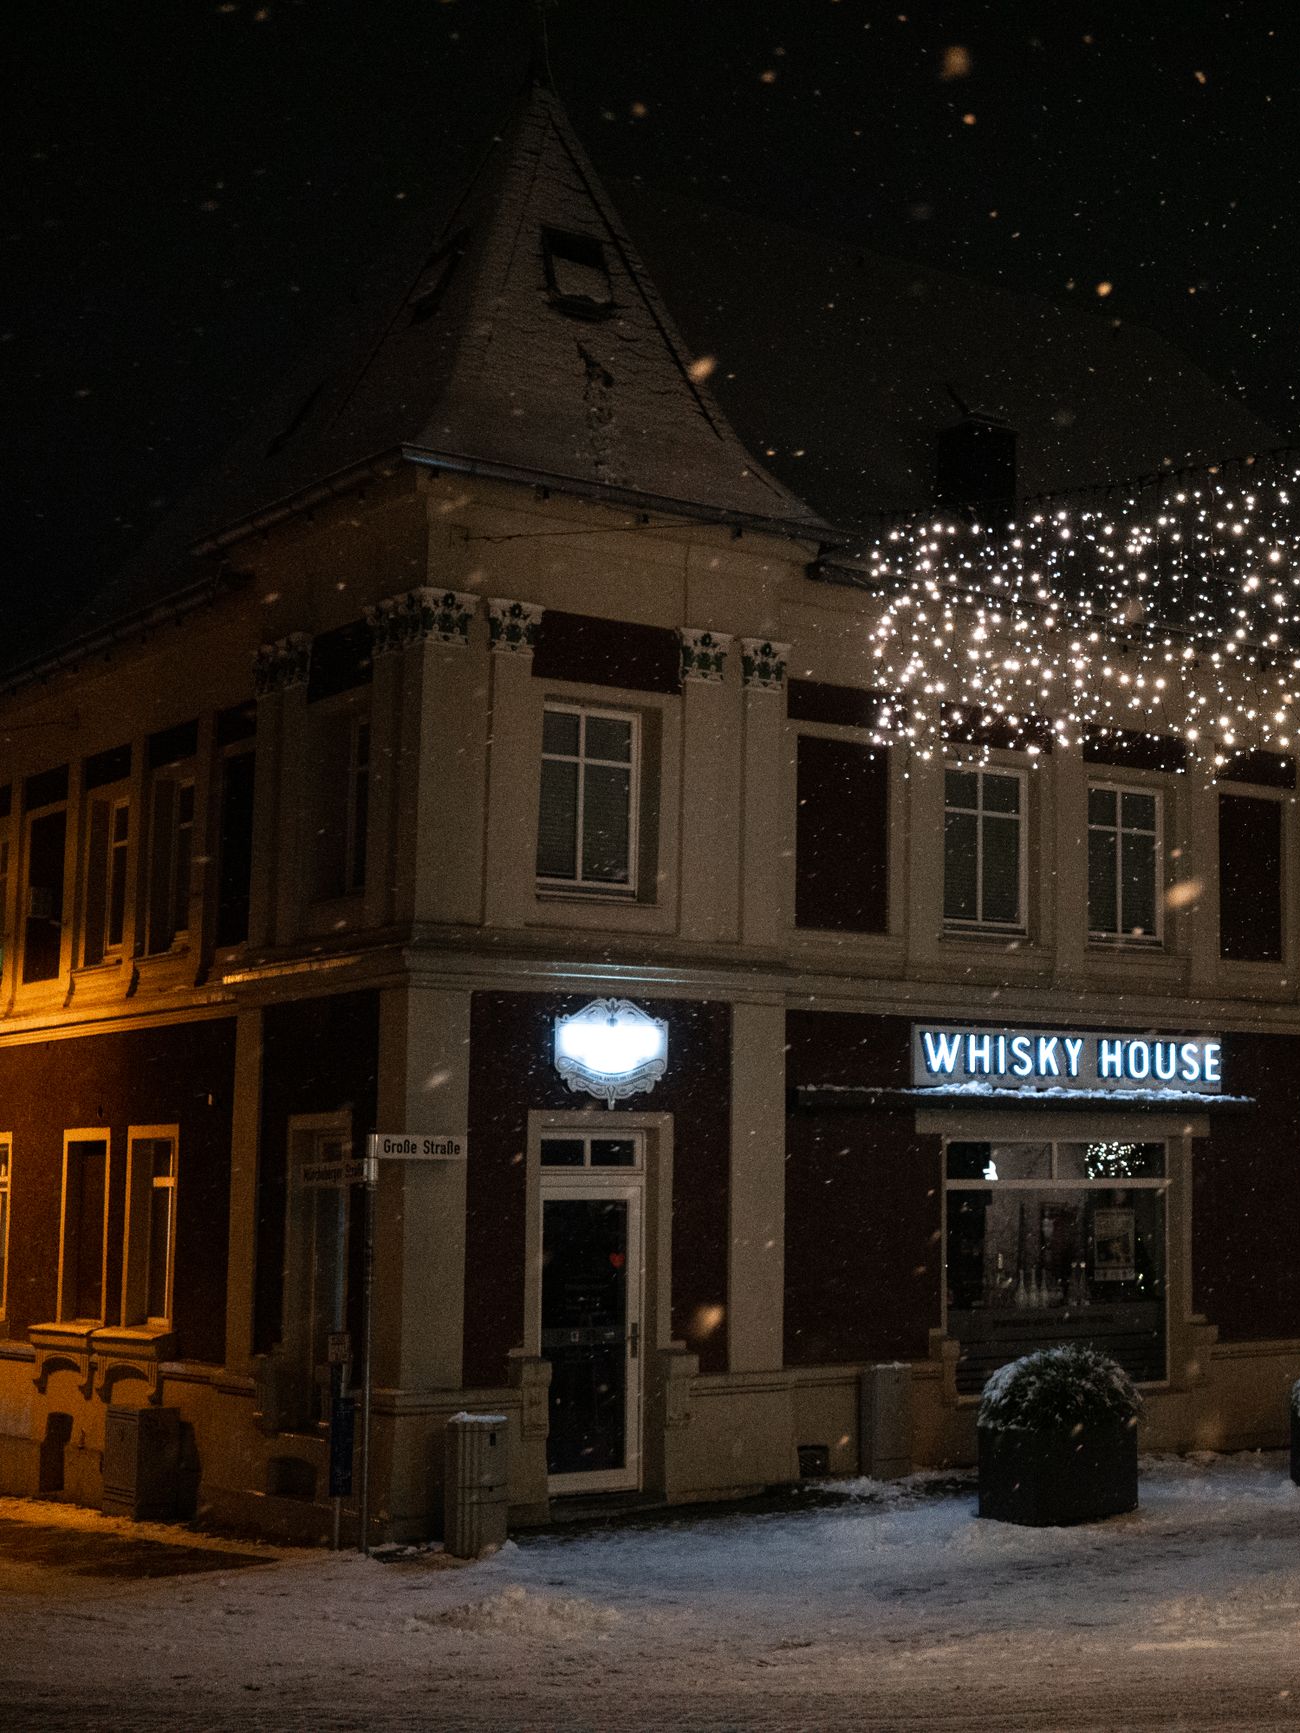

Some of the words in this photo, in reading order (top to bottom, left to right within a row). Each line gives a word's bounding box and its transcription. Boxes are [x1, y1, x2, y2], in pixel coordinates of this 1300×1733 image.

[922, 1031, 1083, 1077] WHISKY
[1099, 1038, 1221, 1082] HOUSE
[383, 1139, 417, 1154] Große
[423, 1140, 461, 1155] Straße
